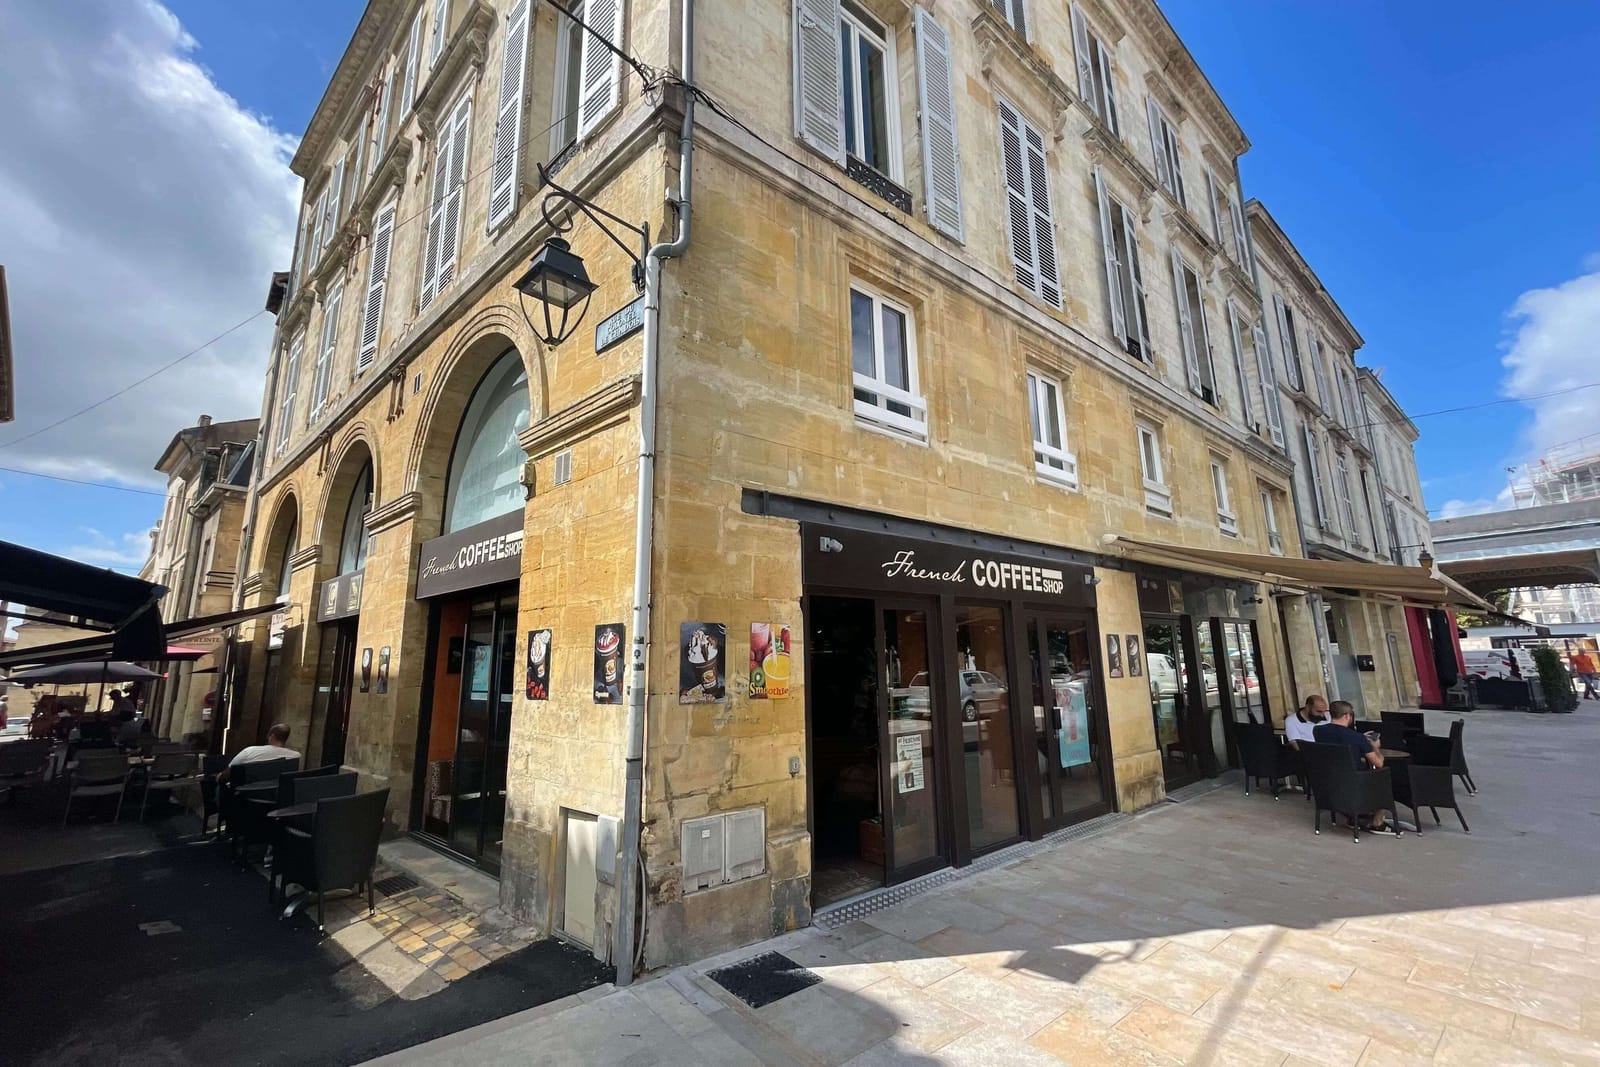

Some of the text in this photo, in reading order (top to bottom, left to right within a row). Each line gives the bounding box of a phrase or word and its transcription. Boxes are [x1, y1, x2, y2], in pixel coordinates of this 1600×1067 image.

[422, 535, 506, 579] French COFFEE
[504, 541, 523, 558] SHOP
[881, 550, 1043, 592] French COFFEE
[1042, 579, 1064, 595] SHOP
